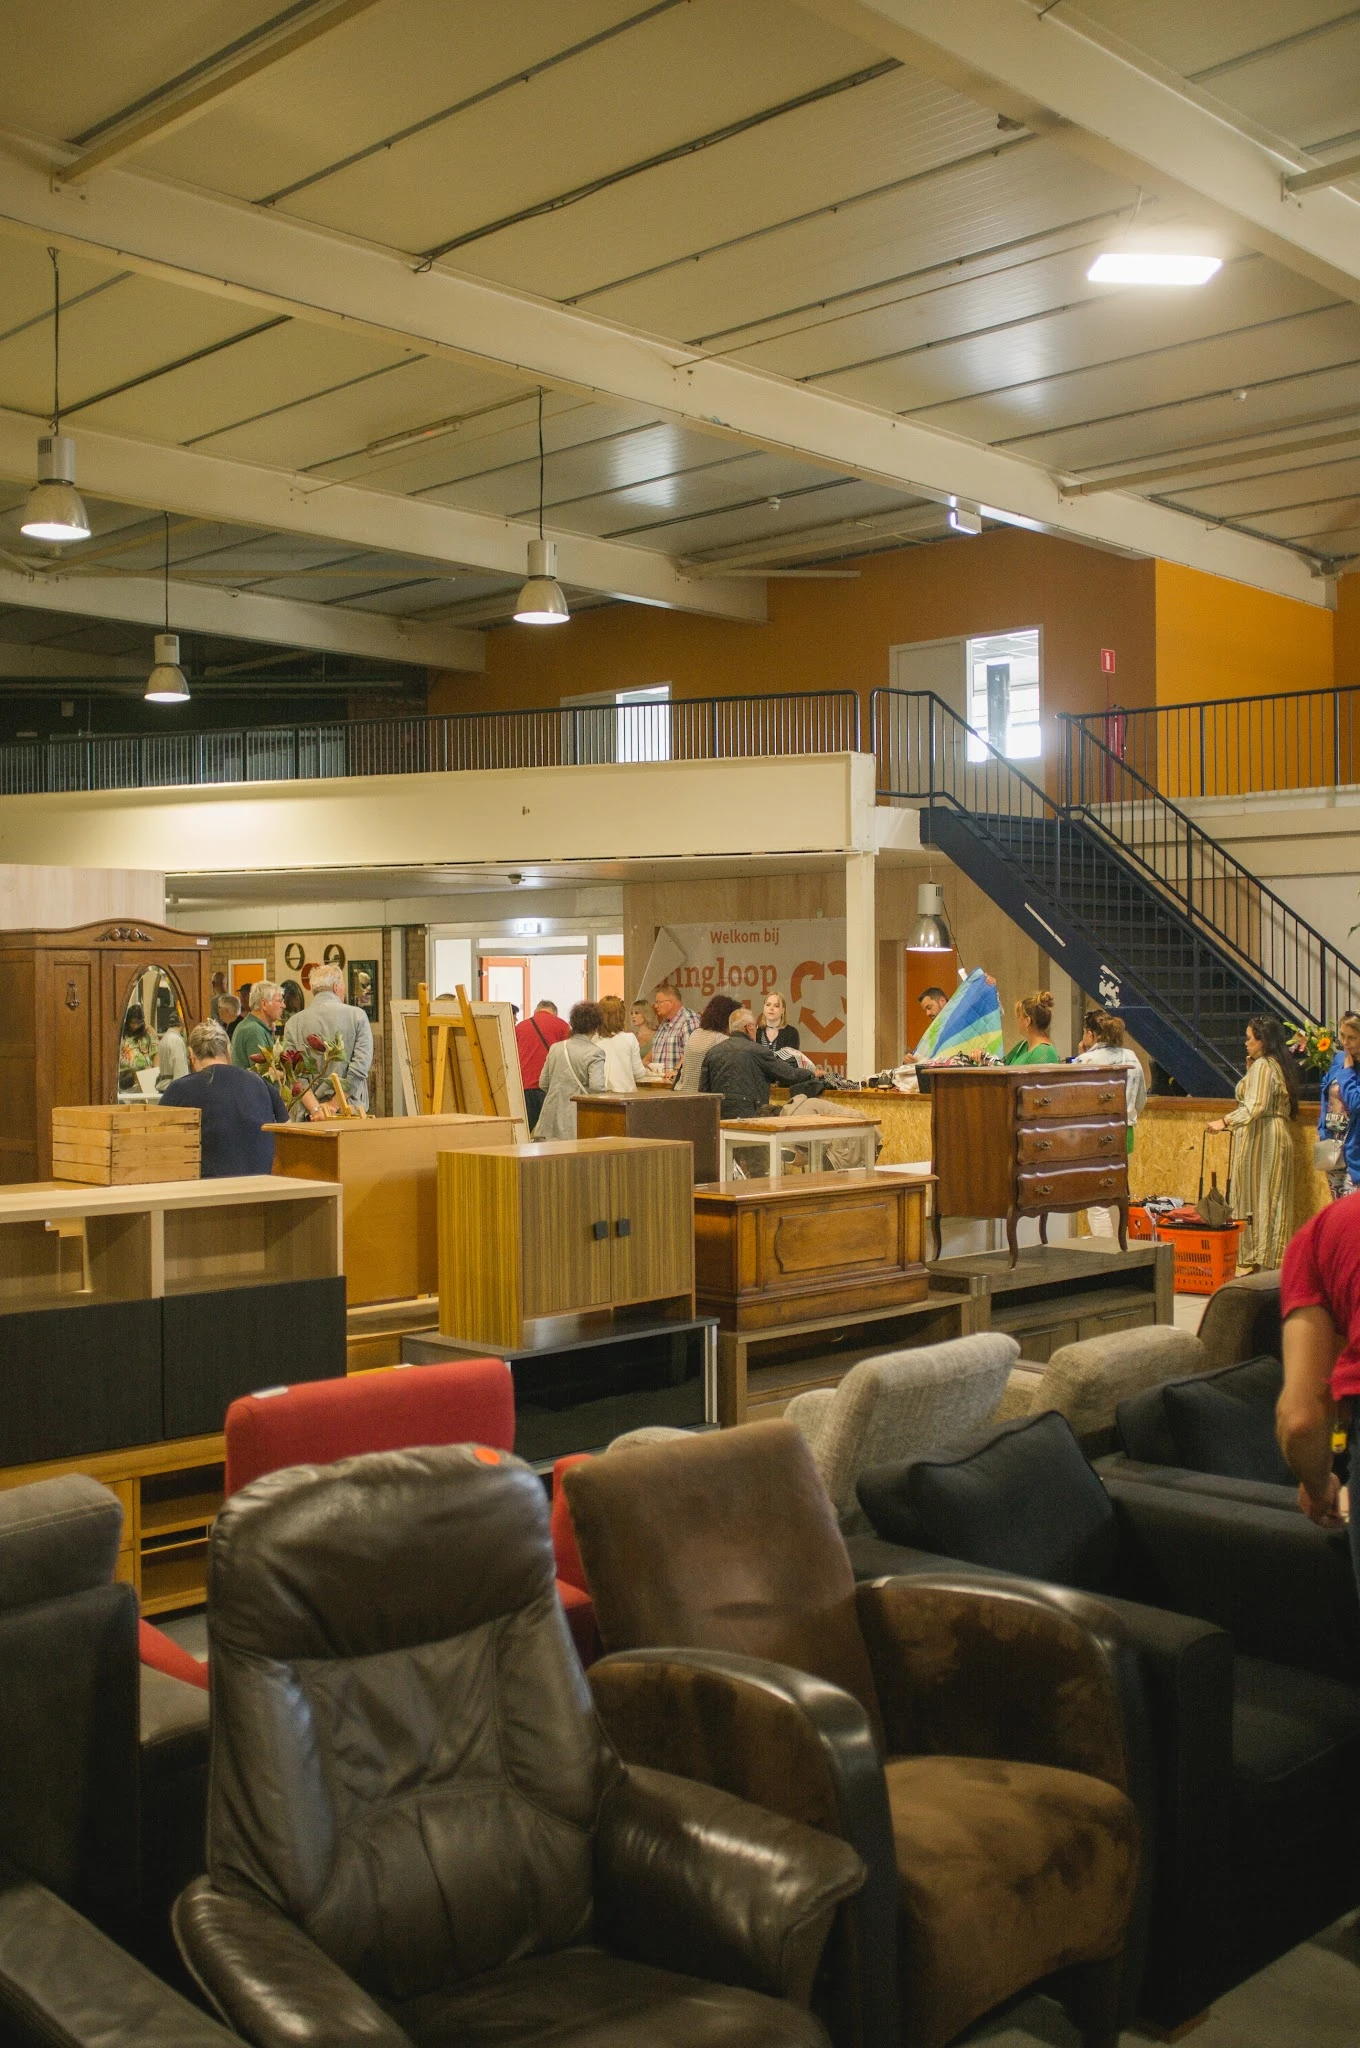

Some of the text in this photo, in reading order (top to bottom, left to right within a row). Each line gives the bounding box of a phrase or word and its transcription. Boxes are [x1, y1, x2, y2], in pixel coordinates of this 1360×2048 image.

[710, 928, 780, 946] Welkom bij
[655, 957, 778, 997] ingloop
